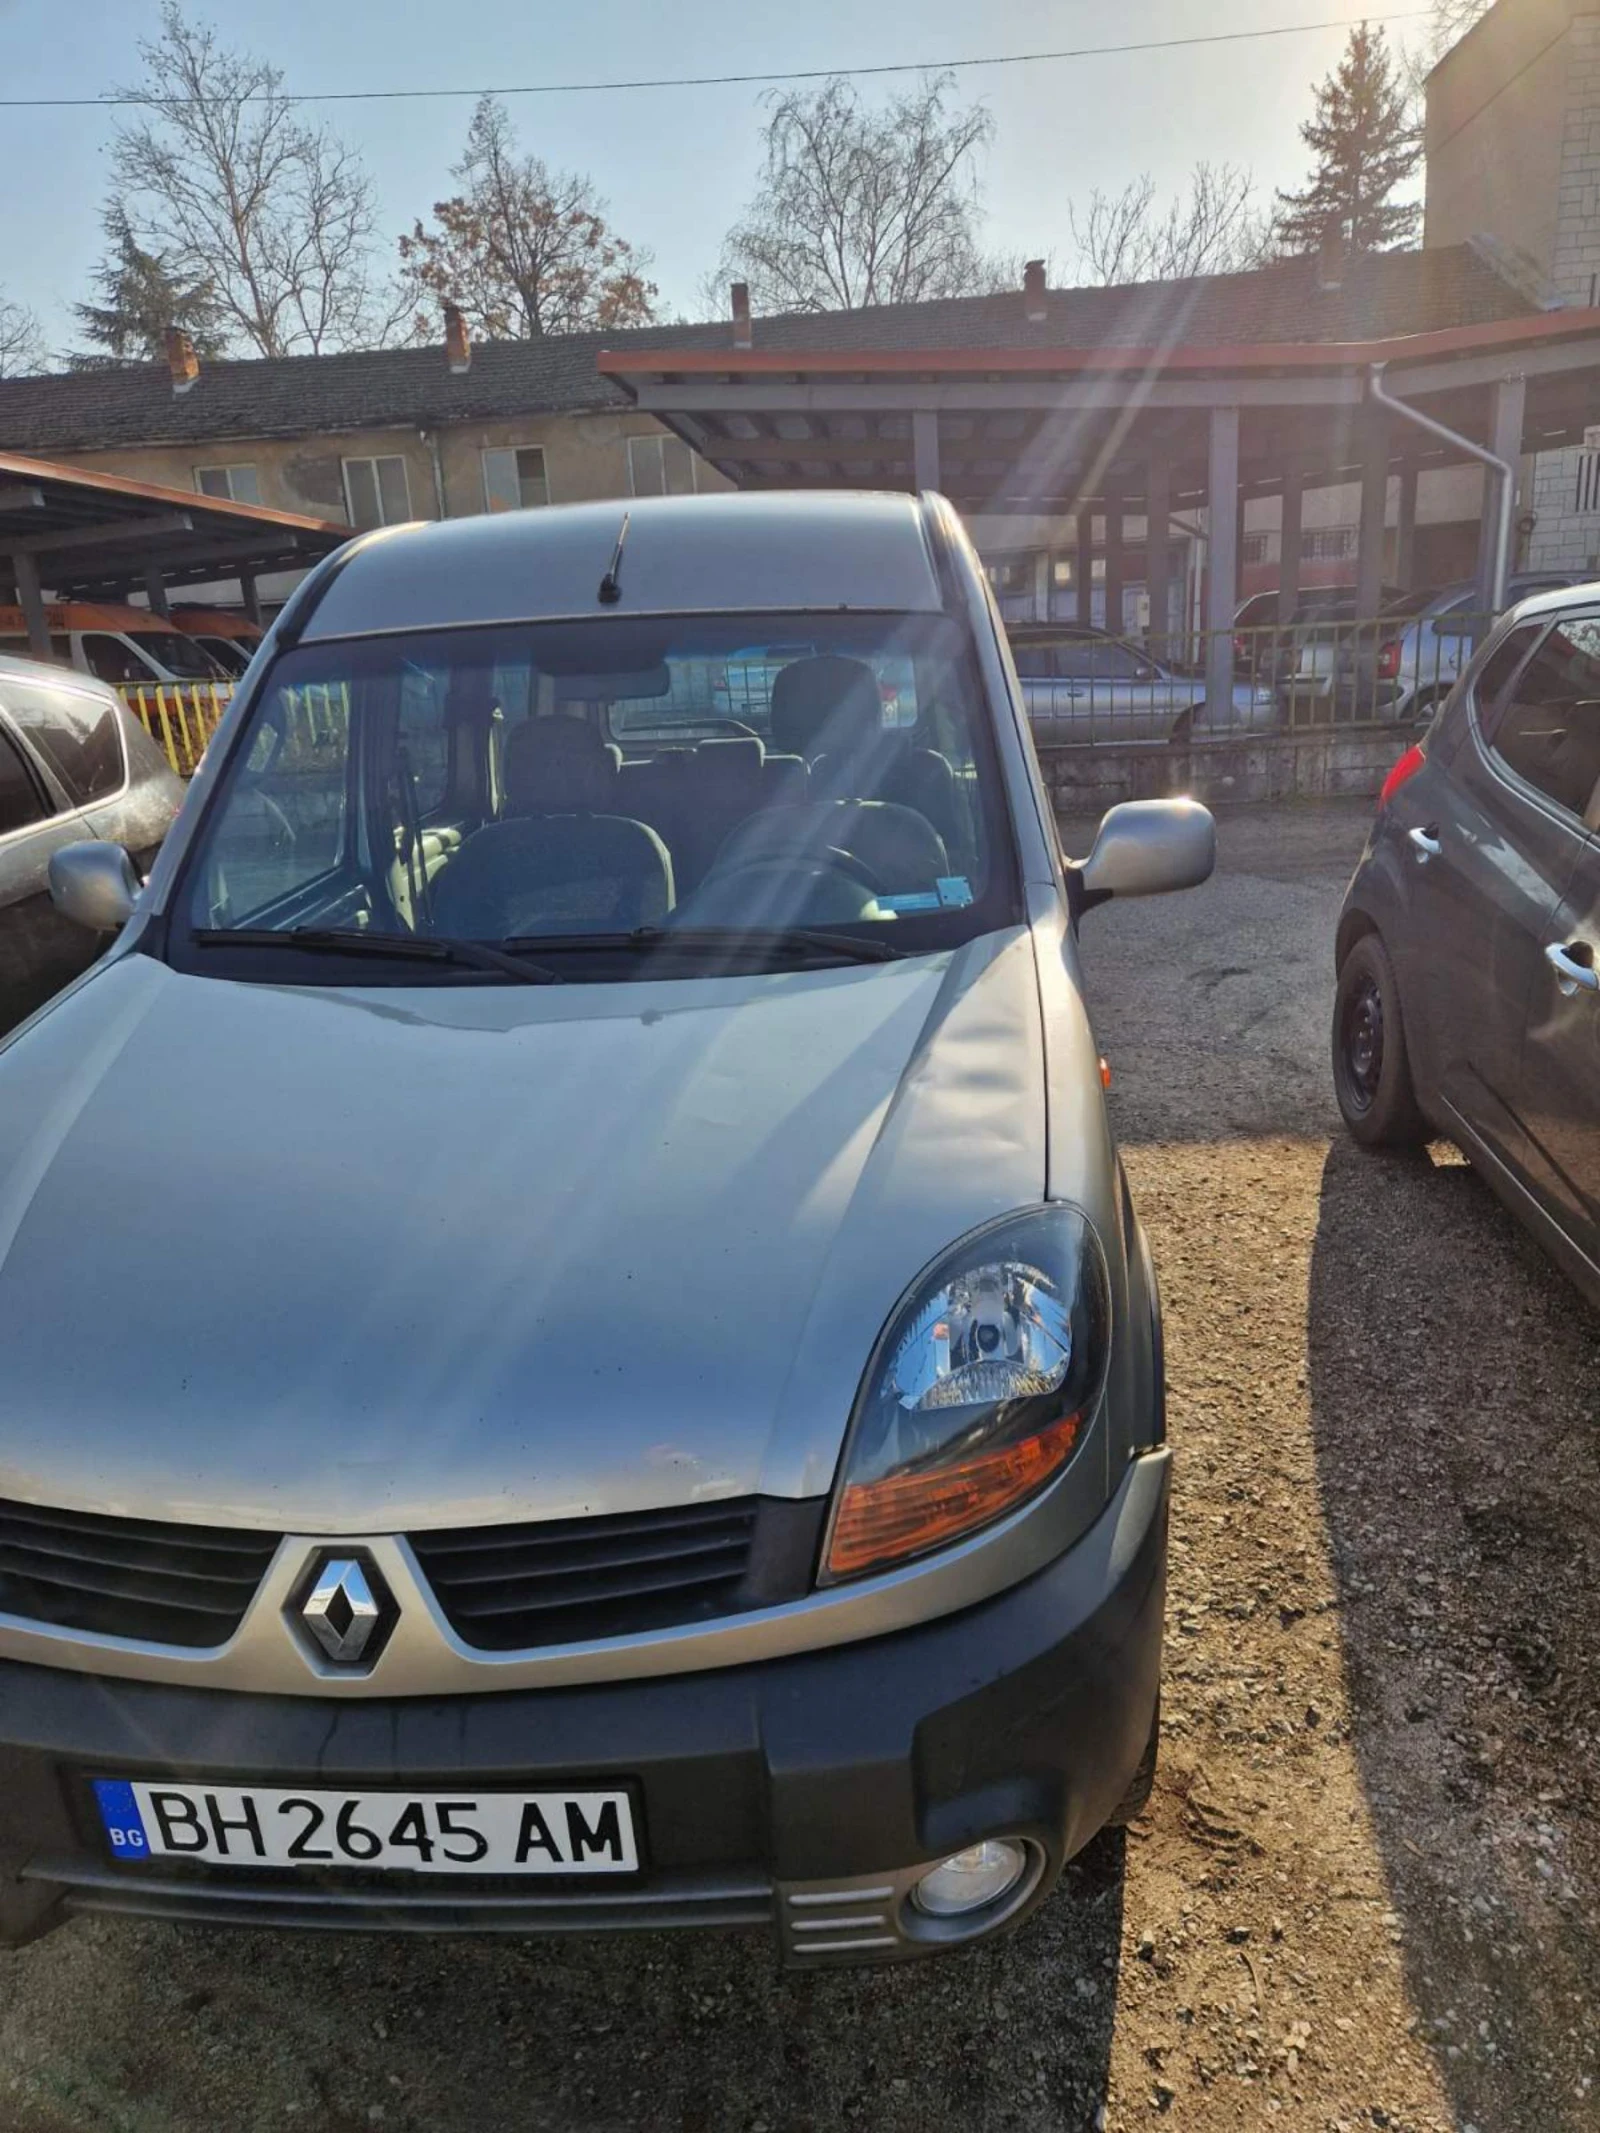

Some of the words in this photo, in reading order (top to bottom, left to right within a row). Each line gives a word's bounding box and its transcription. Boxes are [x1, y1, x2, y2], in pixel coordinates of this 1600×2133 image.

[109, 1827, 144, 1848] BG
[148, 1791, 266, 1857] BH
[277, 1798, 489, 1863] 2645
[513, 1800, 624, 1863] AM
